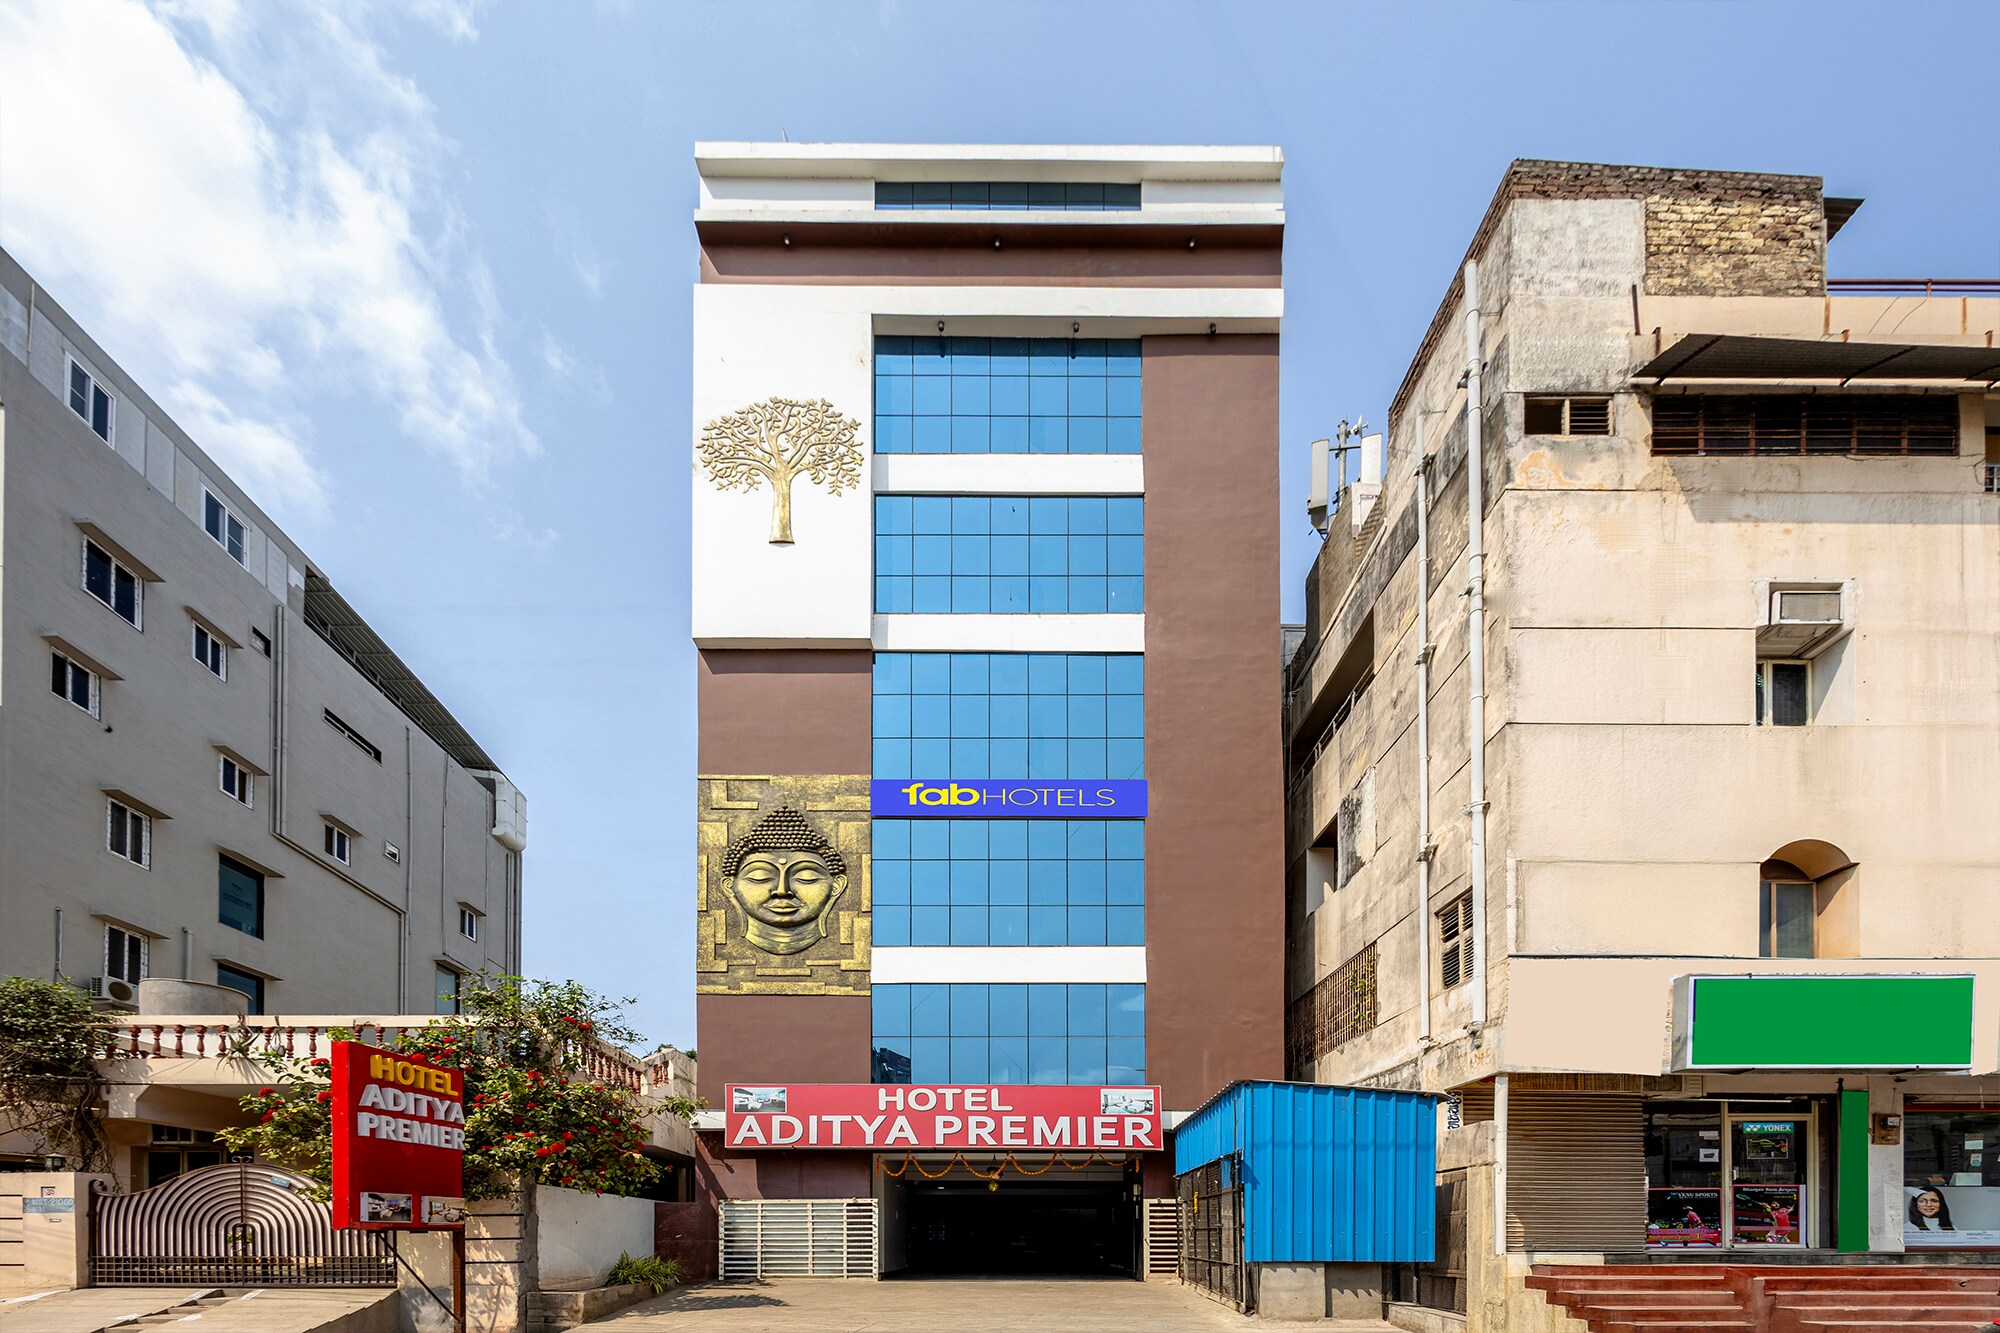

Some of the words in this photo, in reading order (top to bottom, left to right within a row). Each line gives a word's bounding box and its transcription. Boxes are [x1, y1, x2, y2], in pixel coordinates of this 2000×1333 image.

[370, 1054, 459, 1096] HOTEL
[358, 1084, 466, 1125] ADITYA
[877, 1087, 1014, 1112] HOTEL
[357, 1111, 466, 1150] PREMIER
[732, 1115, 919, 1146] ADITYA
[935, 1116, 1155, 1146] PREMIER
[1763, 1124, 1791, 1132] YONEX
